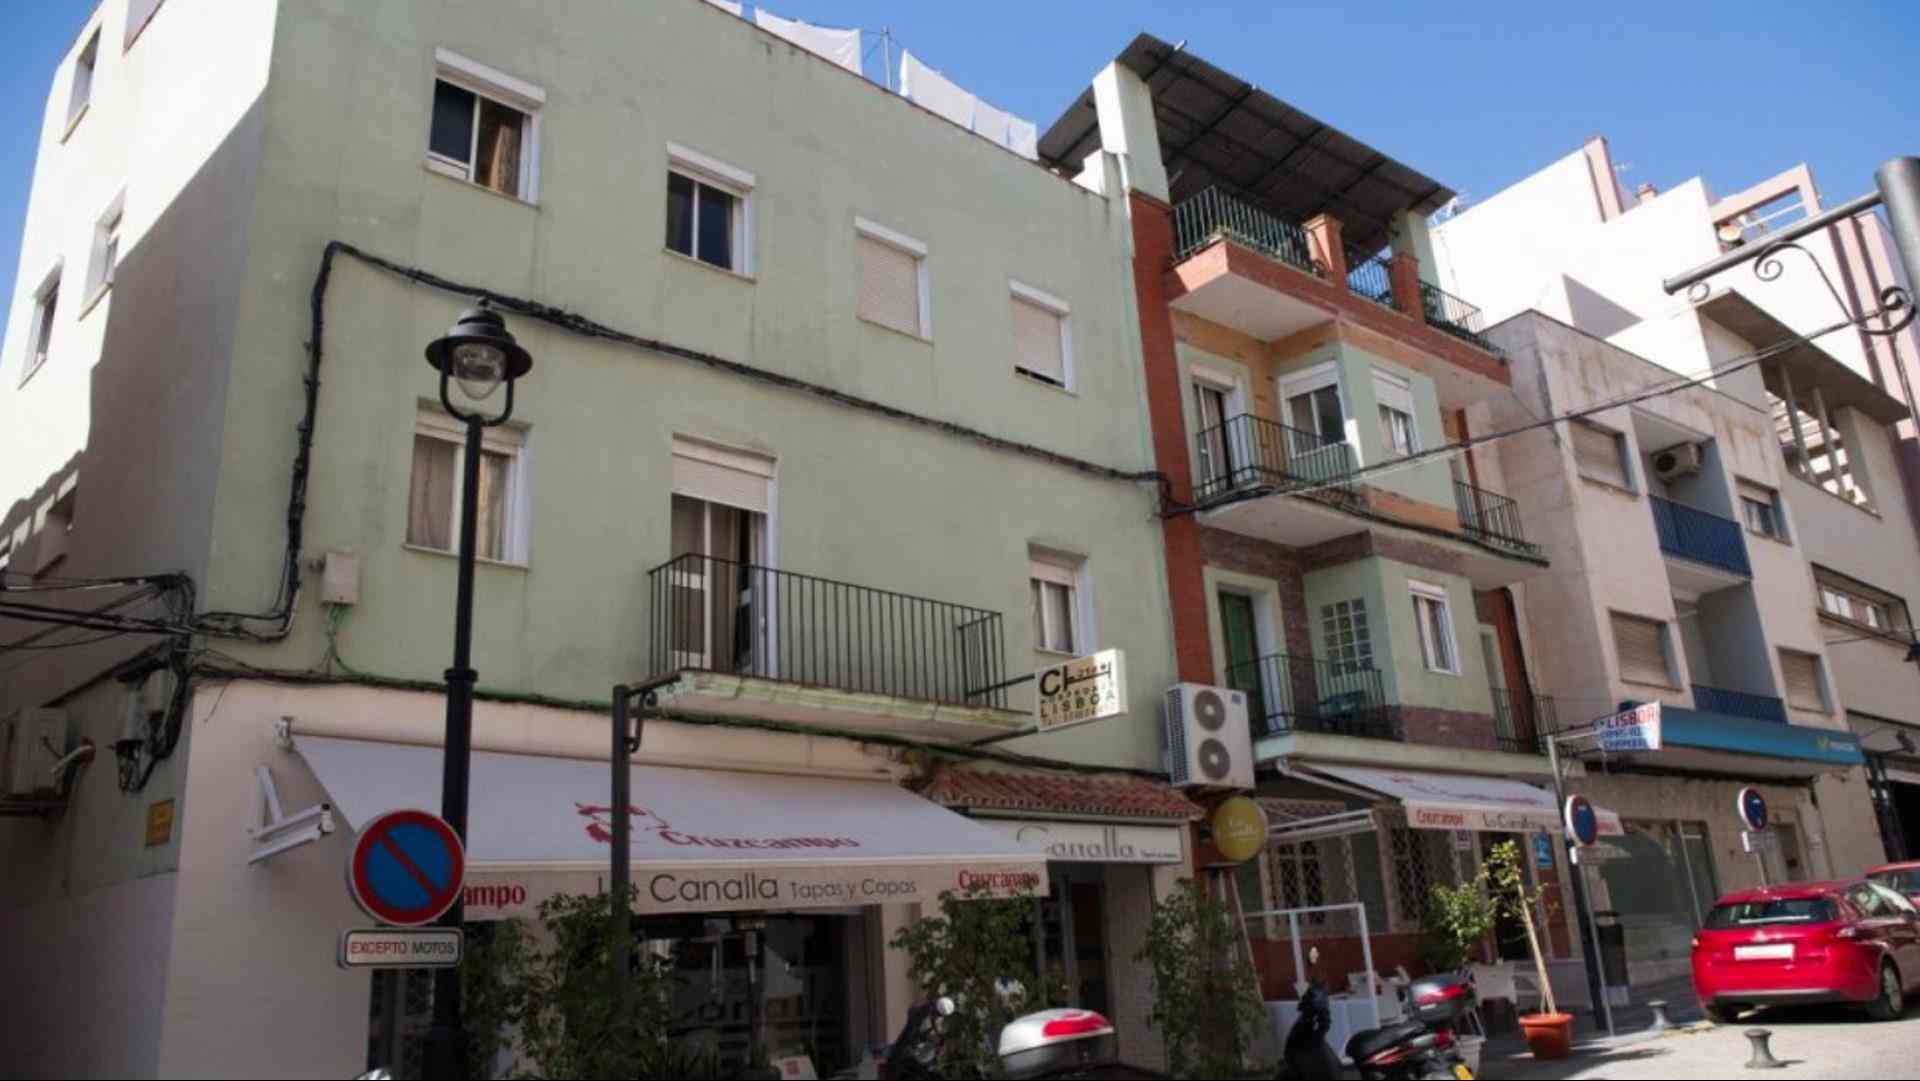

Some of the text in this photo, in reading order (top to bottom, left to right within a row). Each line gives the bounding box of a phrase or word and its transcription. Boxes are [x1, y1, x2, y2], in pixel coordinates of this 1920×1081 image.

[658, 829, 861, 849] Cruzcampo
[463, 884, 526, 910] ampo
[650, 873, 778, 902] Canalla
[791, 880, 842, 900] Tapas
[844, 883, 856, 900] y
[861, 877, 917, 897] Copas
[351, 941, 456, 955] EXCEPTO MOTOS
